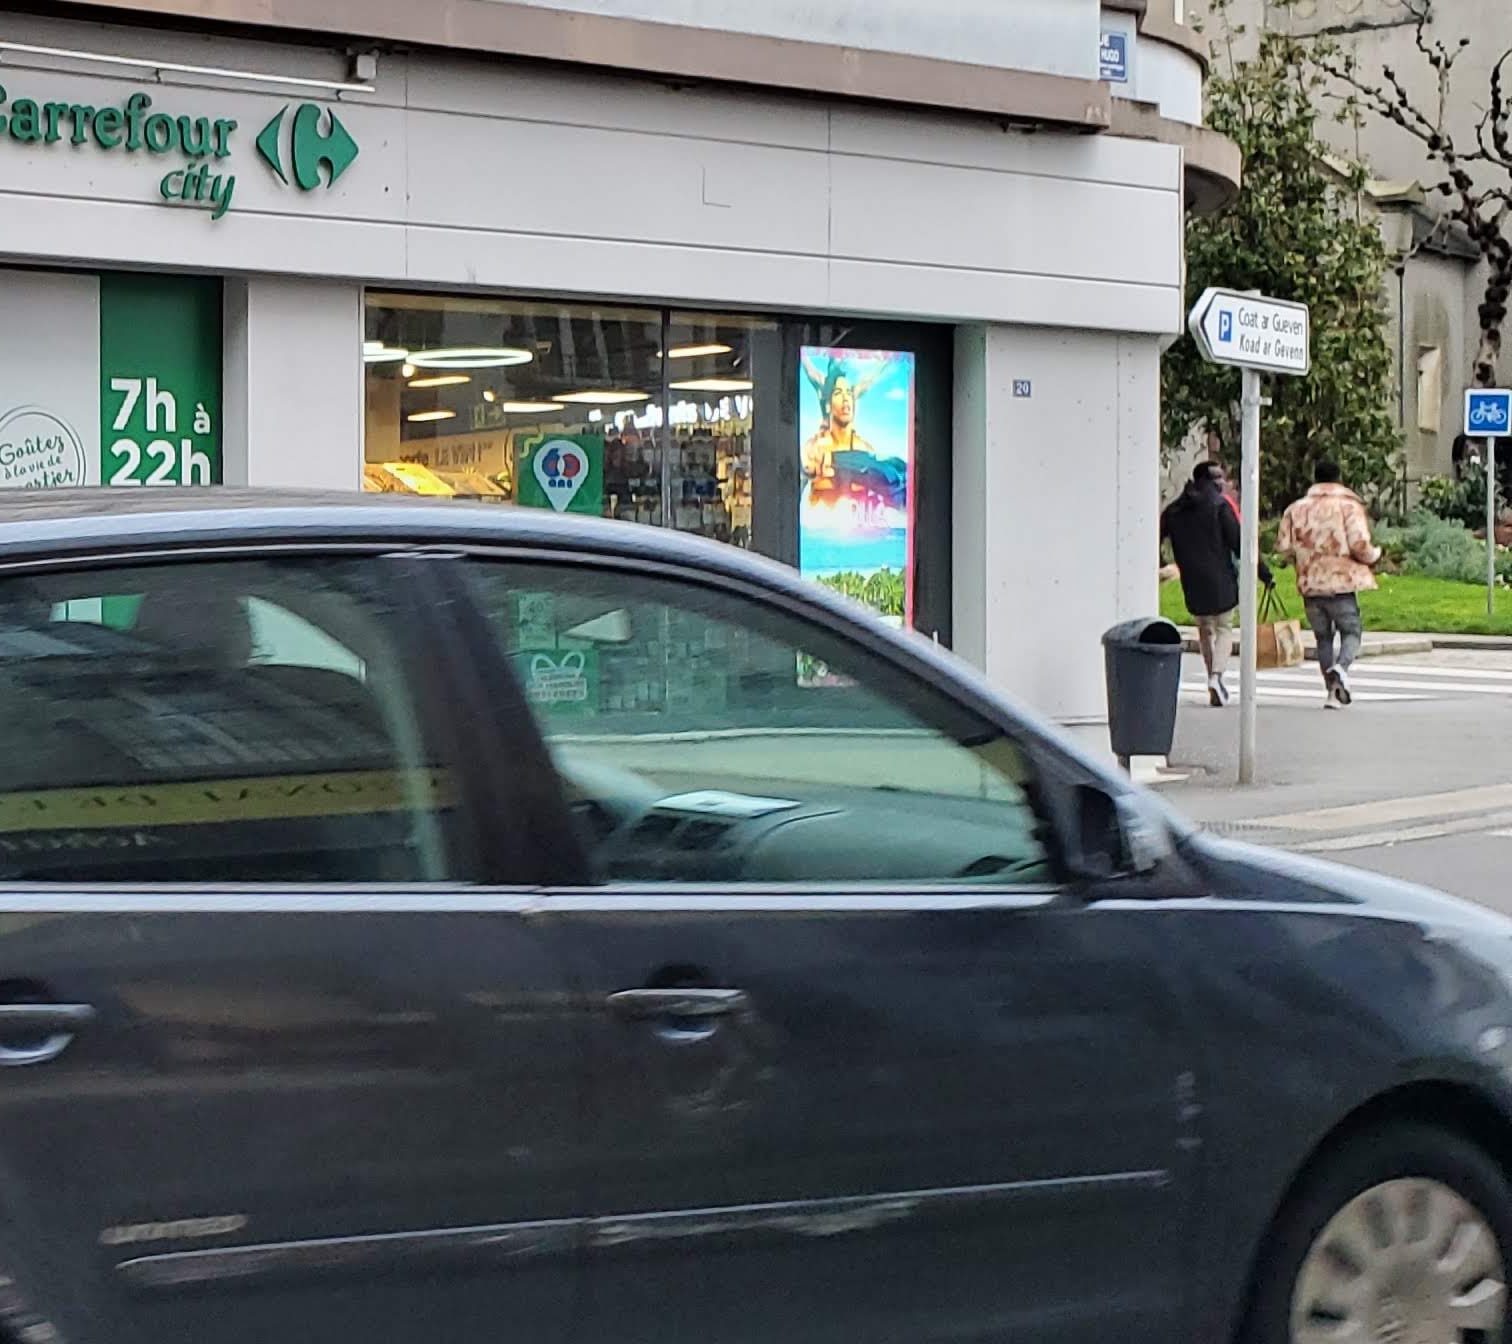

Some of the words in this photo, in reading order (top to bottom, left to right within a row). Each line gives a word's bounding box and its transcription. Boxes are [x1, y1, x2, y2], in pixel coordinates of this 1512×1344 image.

[160, 162, 236, 220] city
[1238, 307, 1259, 328] Coat
[1240, 334, 1261, 354] Koad
[1016, 382, 1029, 395] 20
[110, 378, 176, 432] 7h
[194, 402, 211, 434] à
[4, 467, 12, 480] à
[14, 464, 26, 477] la
[29, 461, 44, 472] vie
[48, 455, 61, 467] de
[110, 438, 211, 486] 22h
